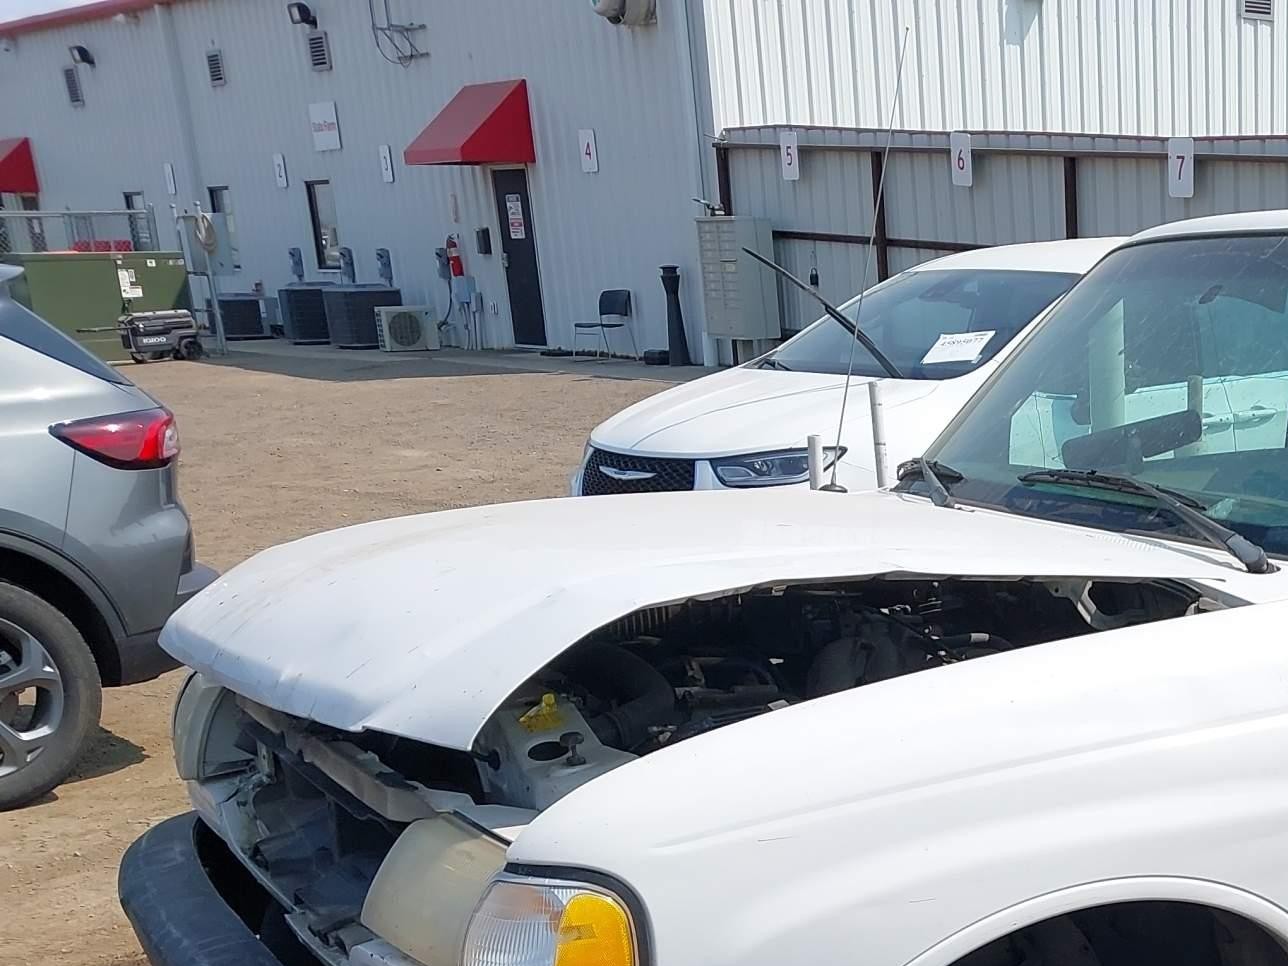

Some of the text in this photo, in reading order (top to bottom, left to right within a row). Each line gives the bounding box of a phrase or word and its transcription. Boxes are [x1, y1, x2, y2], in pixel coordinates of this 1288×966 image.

[585, 141, 592, 160] 4
[786, 146, 793, 166] 5
[957, 149, 965, 171] 6
[1175, 155, 1185, 180] 7
